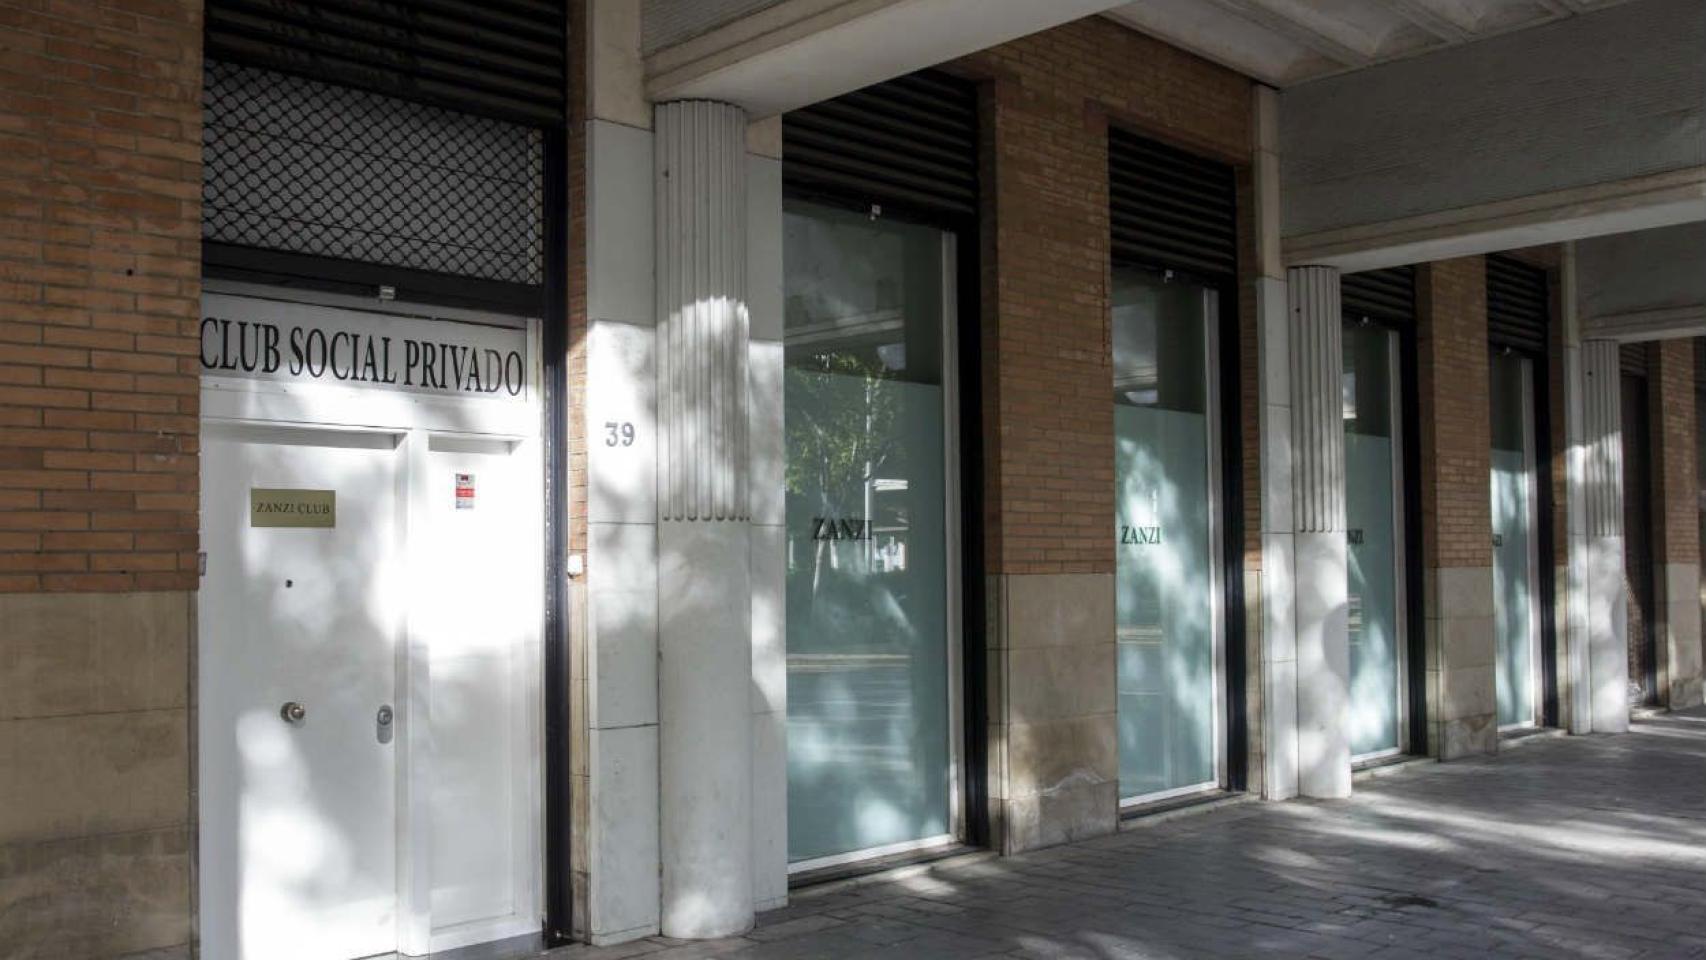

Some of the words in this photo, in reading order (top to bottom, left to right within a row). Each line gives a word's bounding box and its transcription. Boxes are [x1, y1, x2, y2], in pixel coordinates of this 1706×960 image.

[200, 317, 281, 374] CLUB
[289, 326, 397, 383] SOCIAL
[404, 339, 524, 396] PRIVADO
[605, 421, 634, 447] 39
[256, 503, 294, 513] ZANZI
[299, 503, 330, 514] CLUB
[812, 518, 872, 540] ZANZI
[1121, 525, 1160, 544] ZANZI
